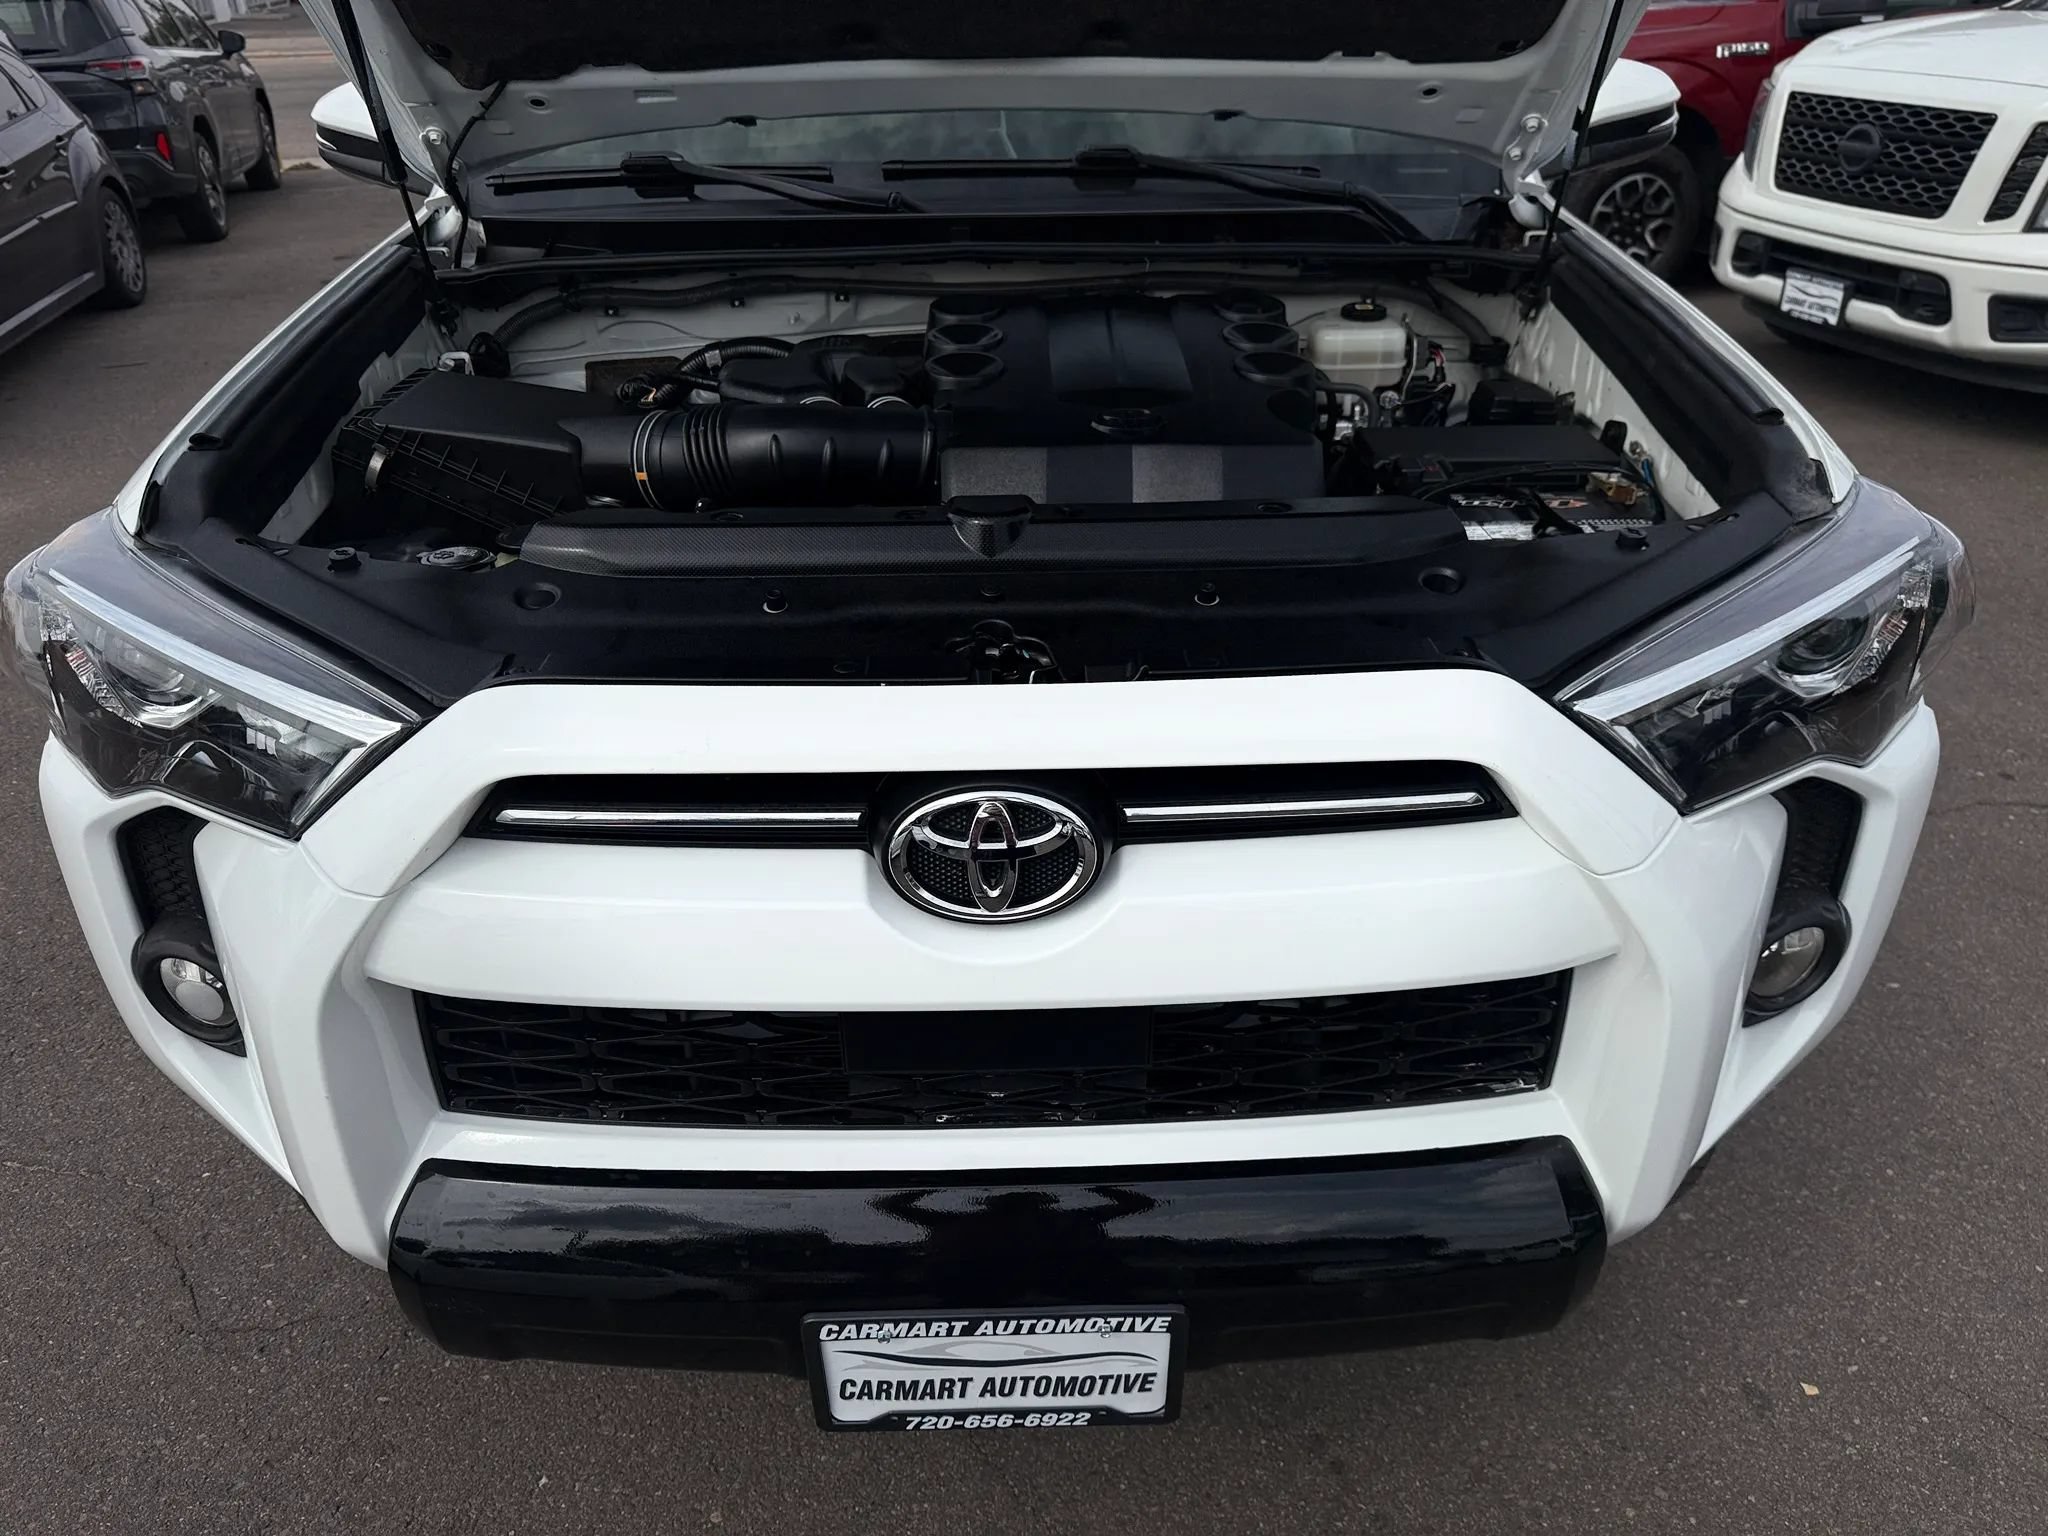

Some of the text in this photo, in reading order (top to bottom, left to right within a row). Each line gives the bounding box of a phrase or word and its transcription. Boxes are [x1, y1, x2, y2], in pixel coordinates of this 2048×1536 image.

[819, 1316, 1172, 1341] CARMART AUTOMOTIVE
[839, 1372, 1157, 1400] CARMART AUTOMOTIVE
[905, 1412, 1091, 1430] 720-656-6922
